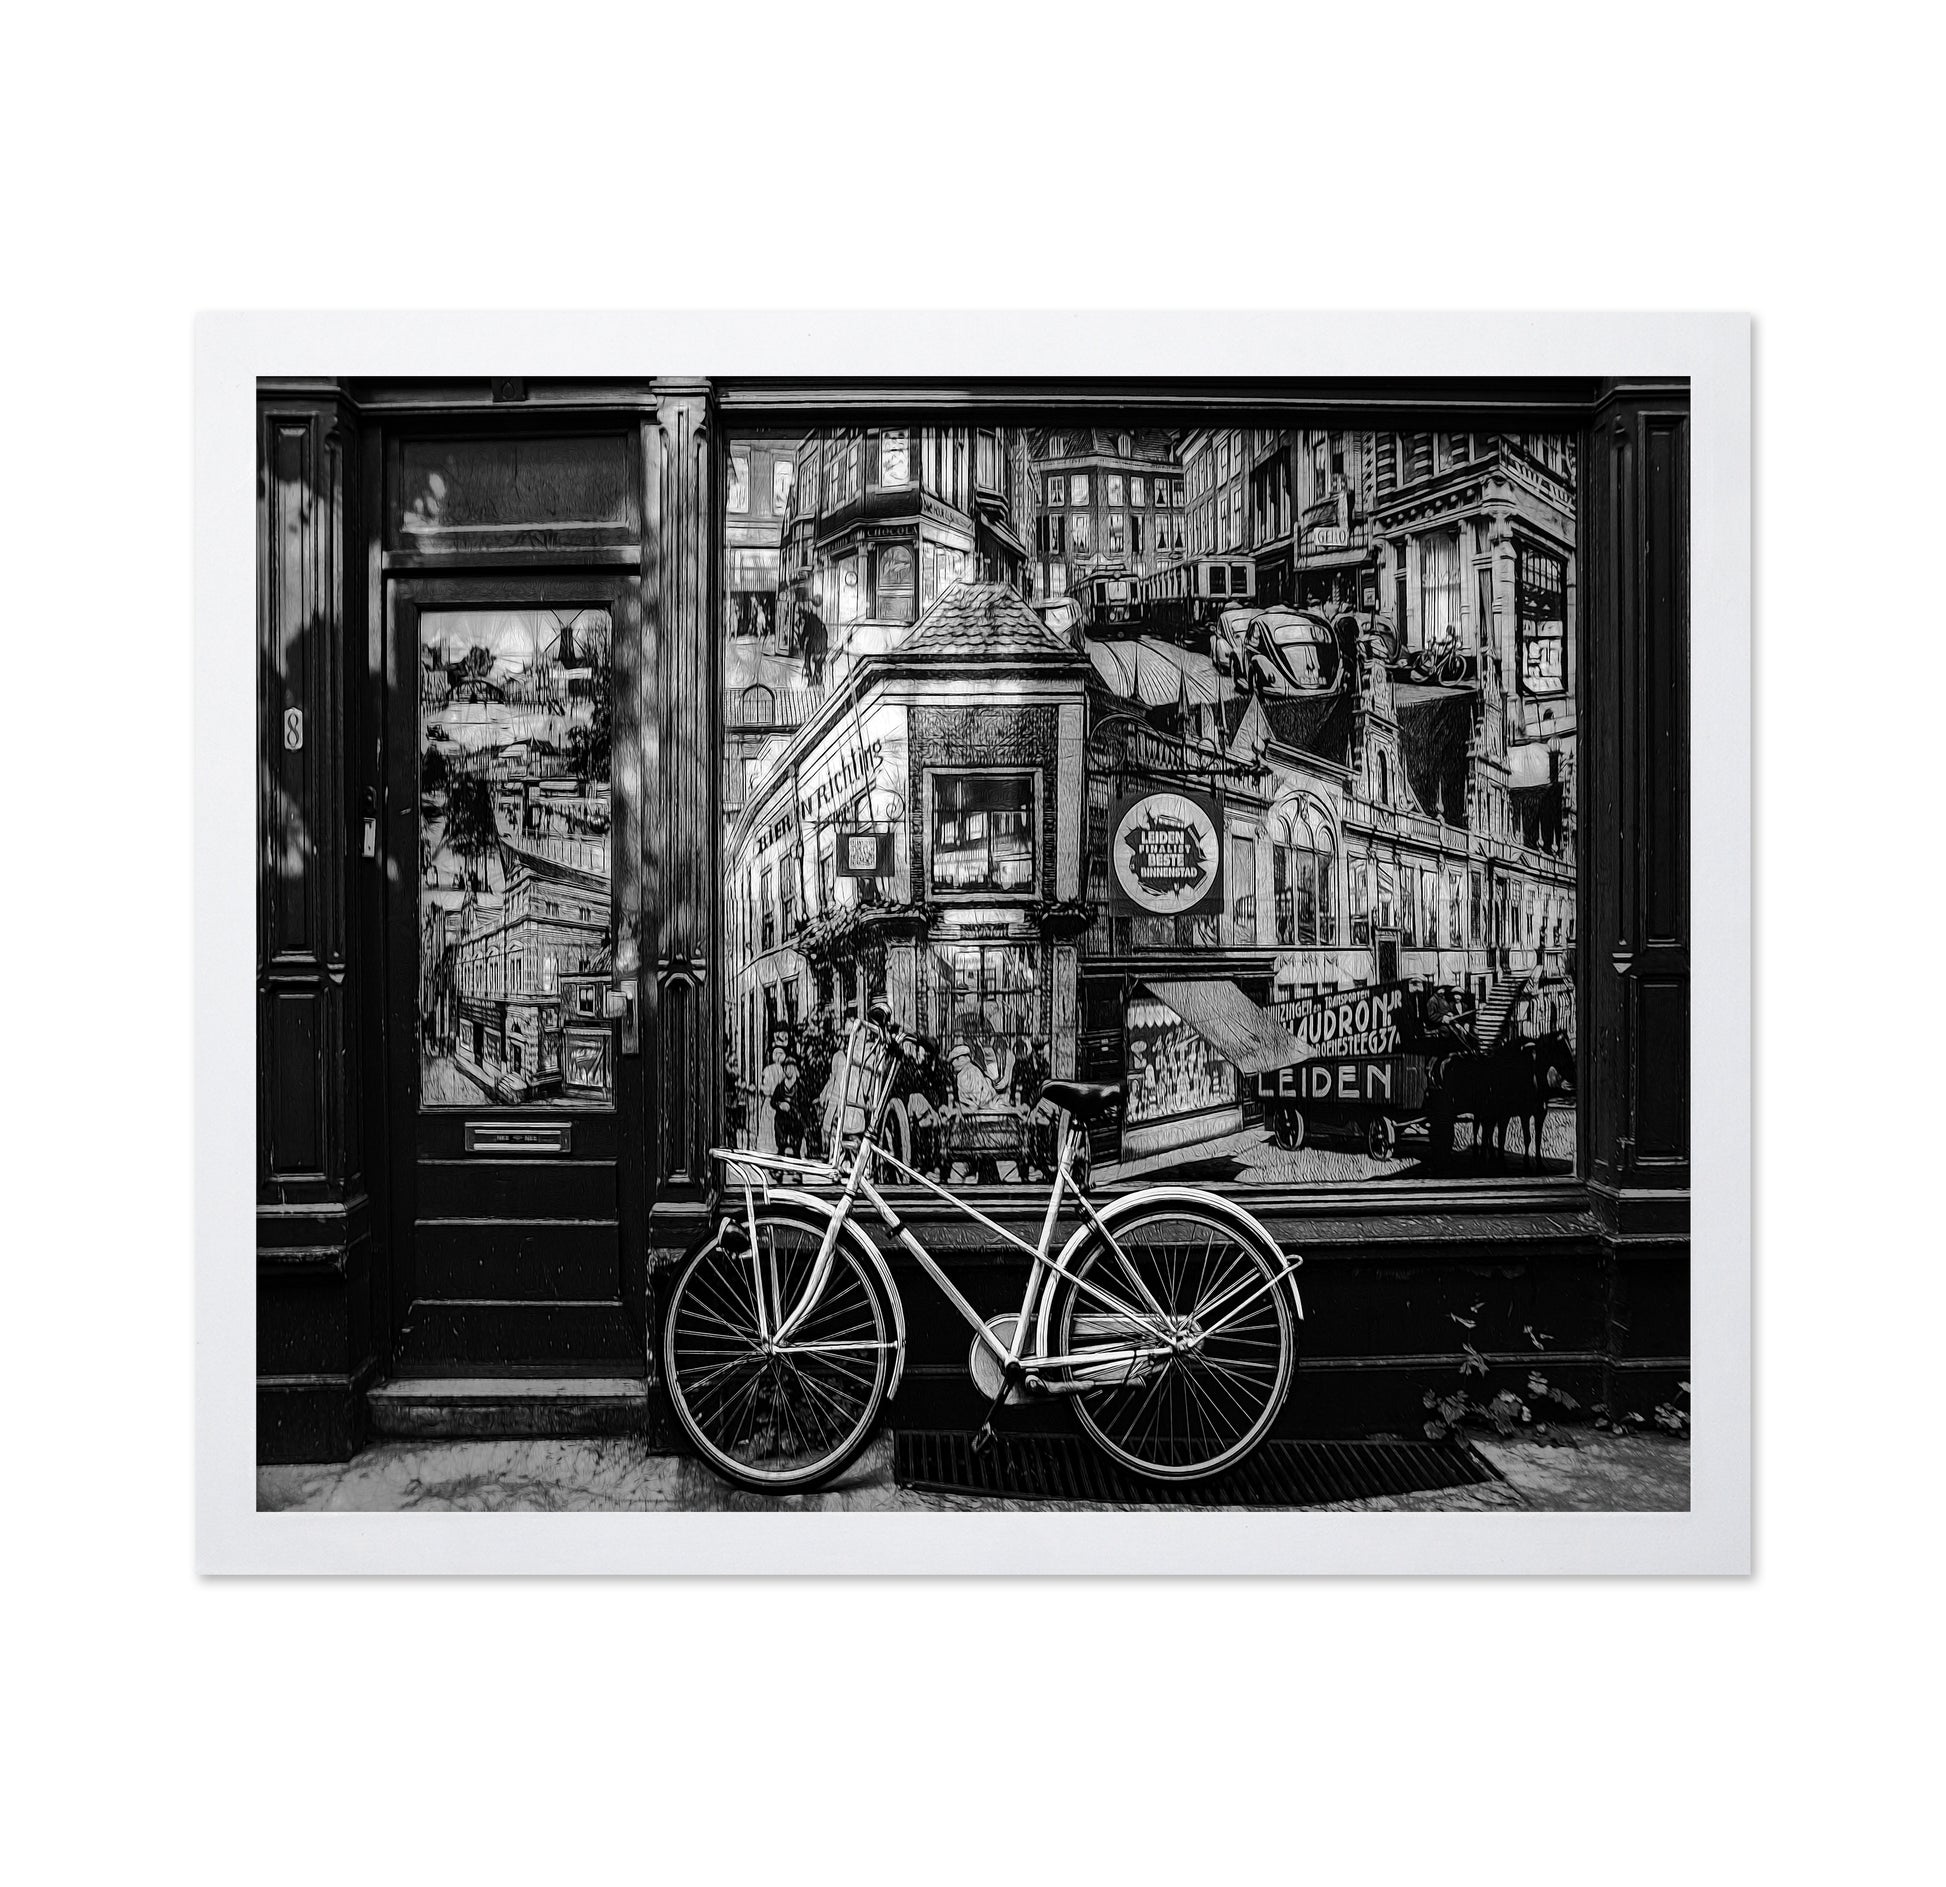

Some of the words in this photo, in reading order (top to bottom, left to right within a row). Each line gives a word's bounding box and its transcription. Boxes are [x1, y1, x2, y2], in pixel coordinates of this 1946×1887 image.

[287, 713, 300, 748] 8
[1141, 830, 1185, 845] LEIDEN
[1138, 844, 1191, 854] FINALIST
[1147, 853, 1185, 867] BESTE
[1140, 866, 1198, 878] BINNENSTAD
[1258, 1063, 1392, 1099] LEIDEN
